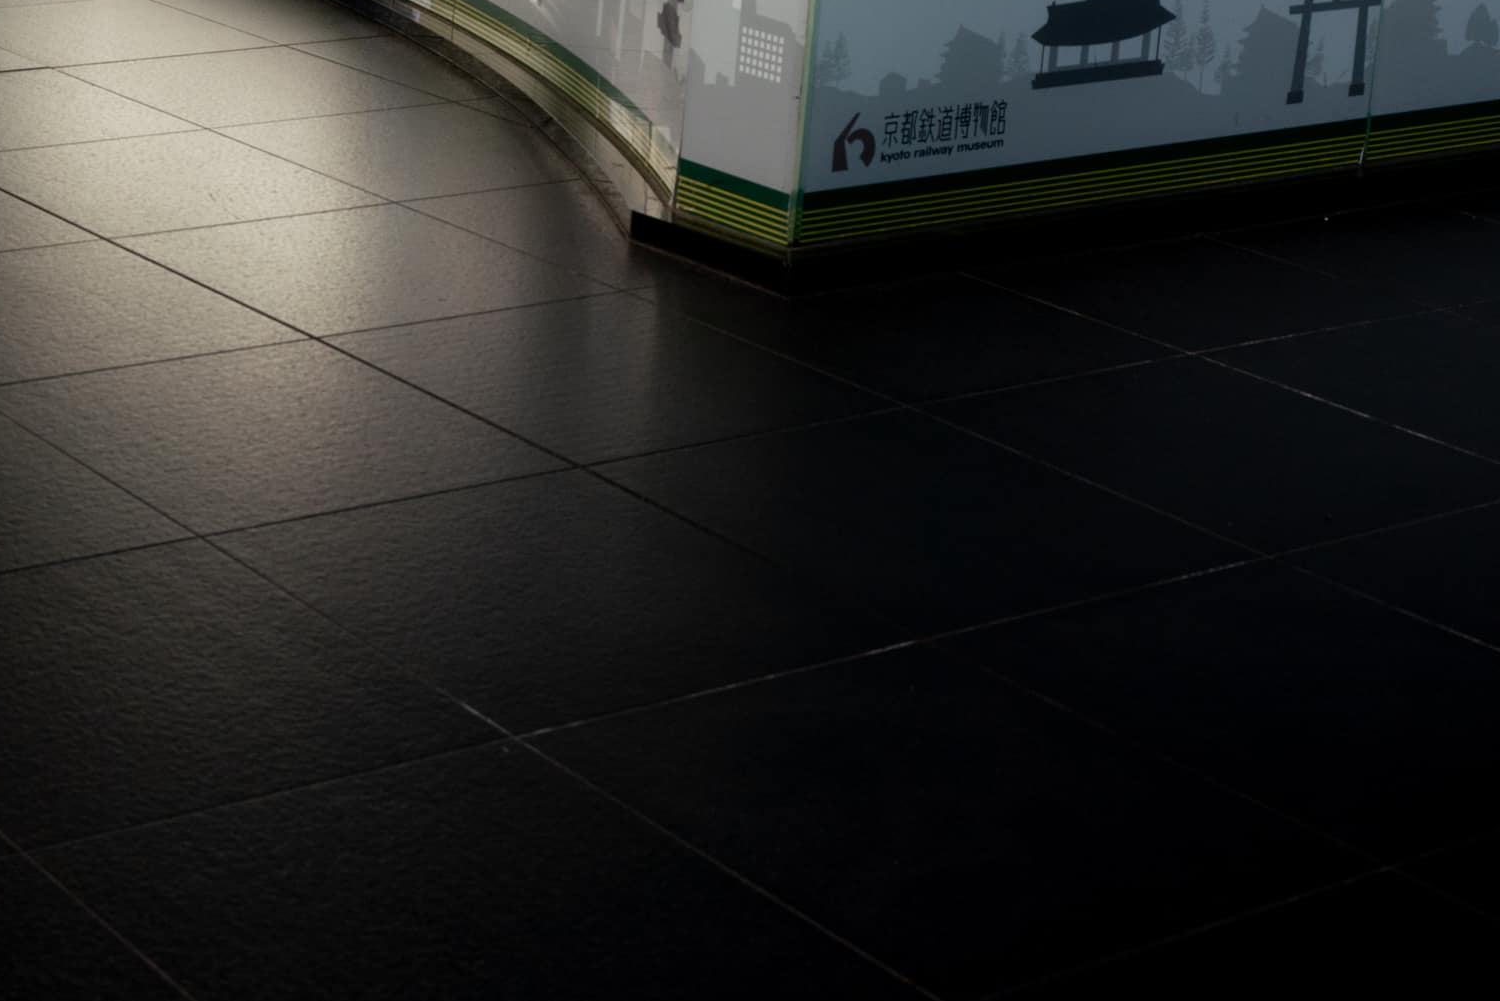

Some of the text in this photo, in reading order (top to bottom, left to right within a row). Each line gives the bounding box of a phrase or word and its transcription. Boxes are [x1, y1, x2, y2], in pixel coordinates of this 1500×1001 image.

[883, 99, 1007, 147] 京都鉄道博物館
[881, 138, 1004, 163] kyoto railway museum
